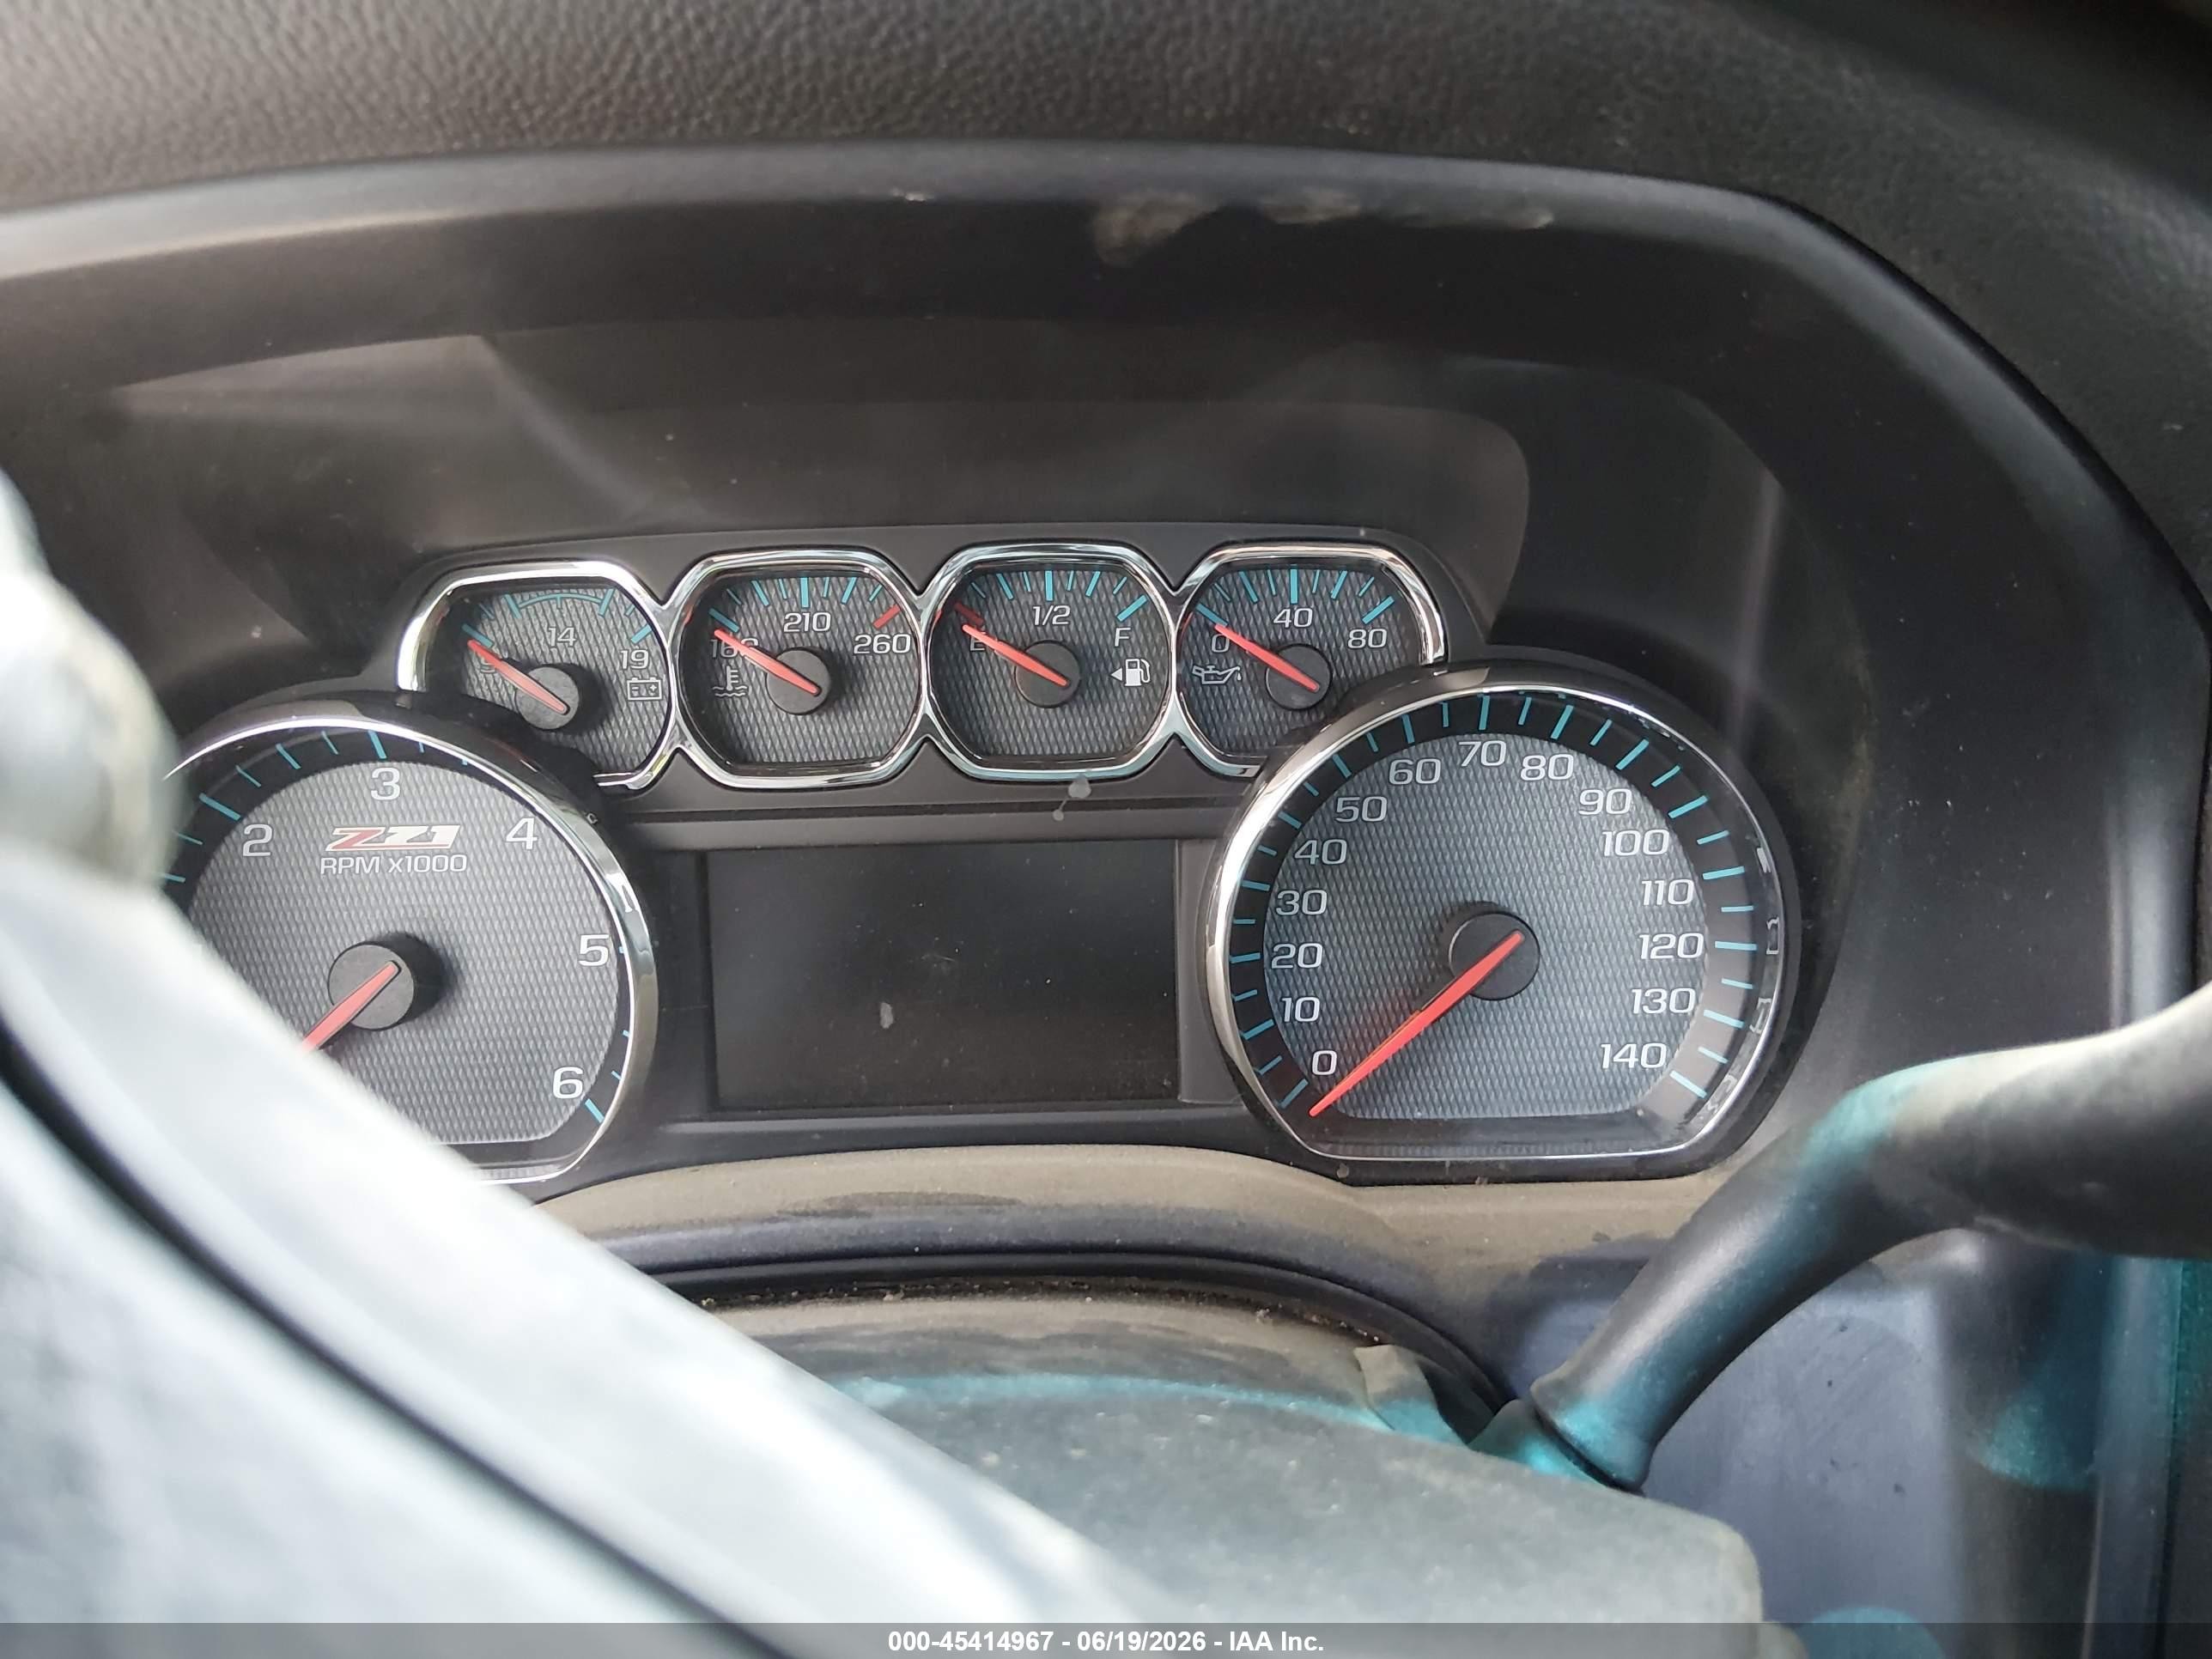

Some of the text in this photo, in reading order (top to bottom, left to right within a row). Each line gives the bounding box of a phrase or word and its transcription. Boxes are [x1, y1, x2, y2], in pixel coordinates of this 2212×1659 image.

[783, 612, 830, 632] 210
[1032, 605, 1071, 625] 1/2
[1273, 608, 1312, 628] 40
[548, 627, 576, 647] 14
[854, 634, 910, 655] 260
[1114, 627, 1132, 647] F
[1212, 634, 1230, 653] 0
[1347, 630, 1388, 650] 80
[620, 649, 650, 670] 19
[1459, 740, 1507, 767] 70
[1389, 758, 1441, 785] 60
[1520, 754, 1573, 781] 80
[370, 767, 401, 800] 3
[1335, 796, 1388, 823] 50
[1578, 788, 1632, 815] 90
[242, 823, 273, 857] 2
[325, 824, 461, 852] Z71
[506, 817, 538, 850] 4
[1602, 830, 1669, 856] 100
[320, 856, 380, 875] RPM
[1294, 838, 1347, 866] 40
[1276, 890, 1328, 915] 30
[1642, 879, 1694, 906] 110
[579, 933, 611, 967] 5
[1271, 943, 1323, 969] 20
[1639, 933, 1704, 960] 120
[1282, 996, 1320, 1023] 10
[1632, 988, 1696, 1014] 130
[1311, 1049, 1337, 1076] 0
[1601, 1042, 1668, 1069] 140
[551, 1066, 585, 1100] 6
